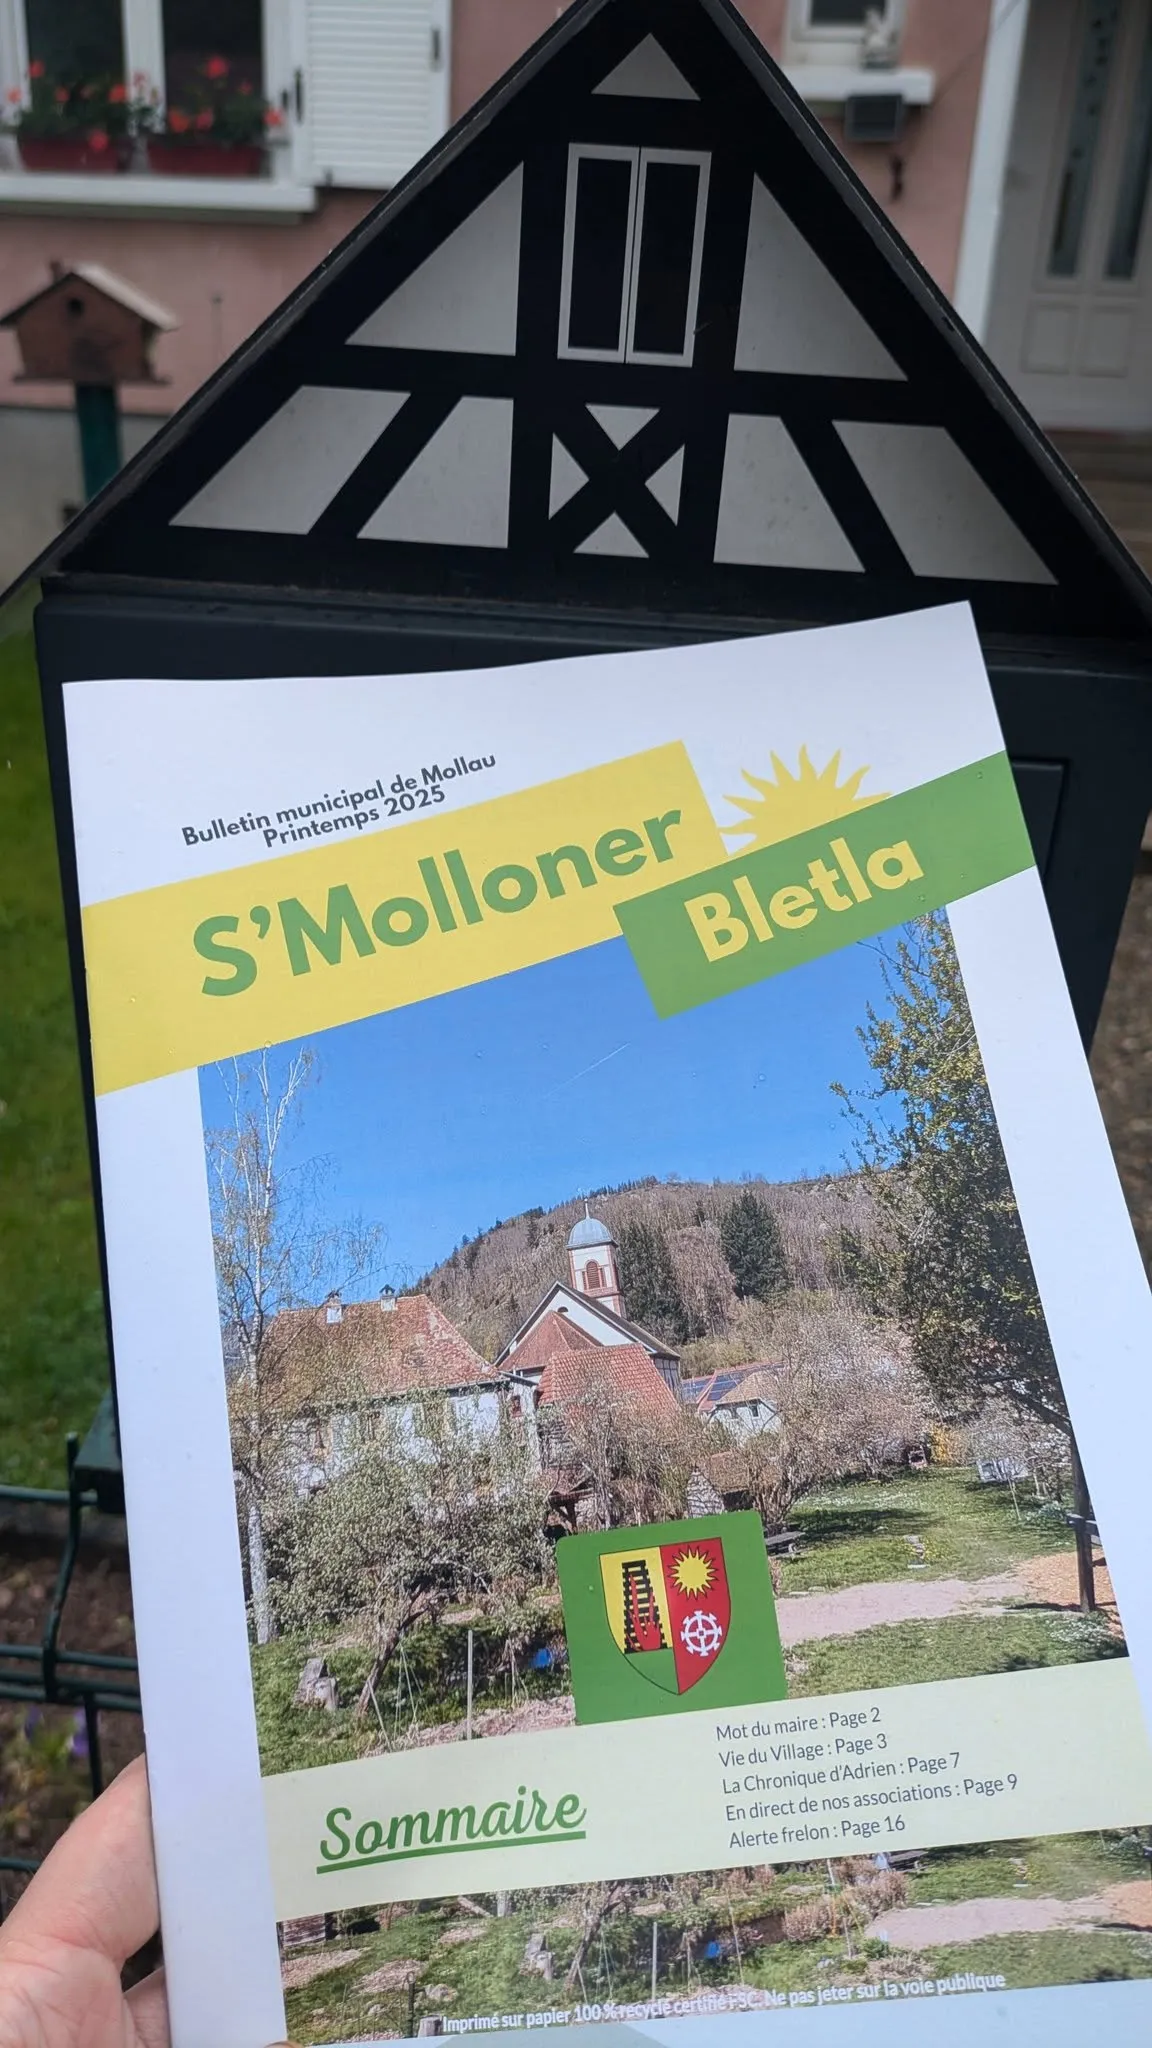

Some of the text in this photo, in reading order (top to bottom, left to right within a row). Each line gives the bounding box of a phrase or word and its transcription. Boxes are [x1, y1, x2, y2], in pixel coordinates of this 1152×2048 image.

[182, 754, 496, 845] Bulletin municipal de Mollau
[263, 785, 445, 848] Printemps 2025
[684, 837, 923, 962] Bletla
[716, 1725, 748, 1741] Mot
[752, 1719, 770, 1737] du
[775, 1716, 818, 1735] maire
[829, 1711, 867, 1729] Page
[870, 1707, 881, 1723] 2
[719, 1750, 744, 1767] Vie
[748, 1746, 767, 1765] du
[770, 1742, 823, 1763] Village
[835, 1737, 873, 1756] Page
[876, 1733, 887, 1749] 3
[723, 1777, 741, 1794] La
[744, 1768, 826, 1792] Chronique
[908, 1755, 947, 1775] Page
[949, 1752, 960, 1768] 7
[726, 1805, 746, 1821] En
[749, 1798, 795, 1819] direct
[798, 1794, 818, 1813] de
[822, 1794, 850, 1811] nos
[853, 1782, 952, 1808] associations
[964, 1777, 1003, 1798] Page
[1007, 1773, 1017, 1790] 9
[319, 1786, 587, 1860] Sommaire
[729, 1830, 778, 1848] Alerte
[782, 1823, 829, 1843] frelon
[841, 1820, 880, 1839] Page
[884, 1815, 905, 1832] 16
[443, 2013, 499, 2034] Imprimé
[502, 2016, 523, 2028] sur
[527, 2008, 572, 2029] papier
[574, 2004, 600, 2022] 100
[764, 1989, 786, 2006] Ne
[789, 1991, 815, 2008] pas
[817, 1986, 854, 2005] jeter
[857, 1985, 880, 1999] sur
[884, 1980, 897, 1997] la
[900, 1979, 934, 1996] voie
[937, 1972, 1006, 1995] publique
